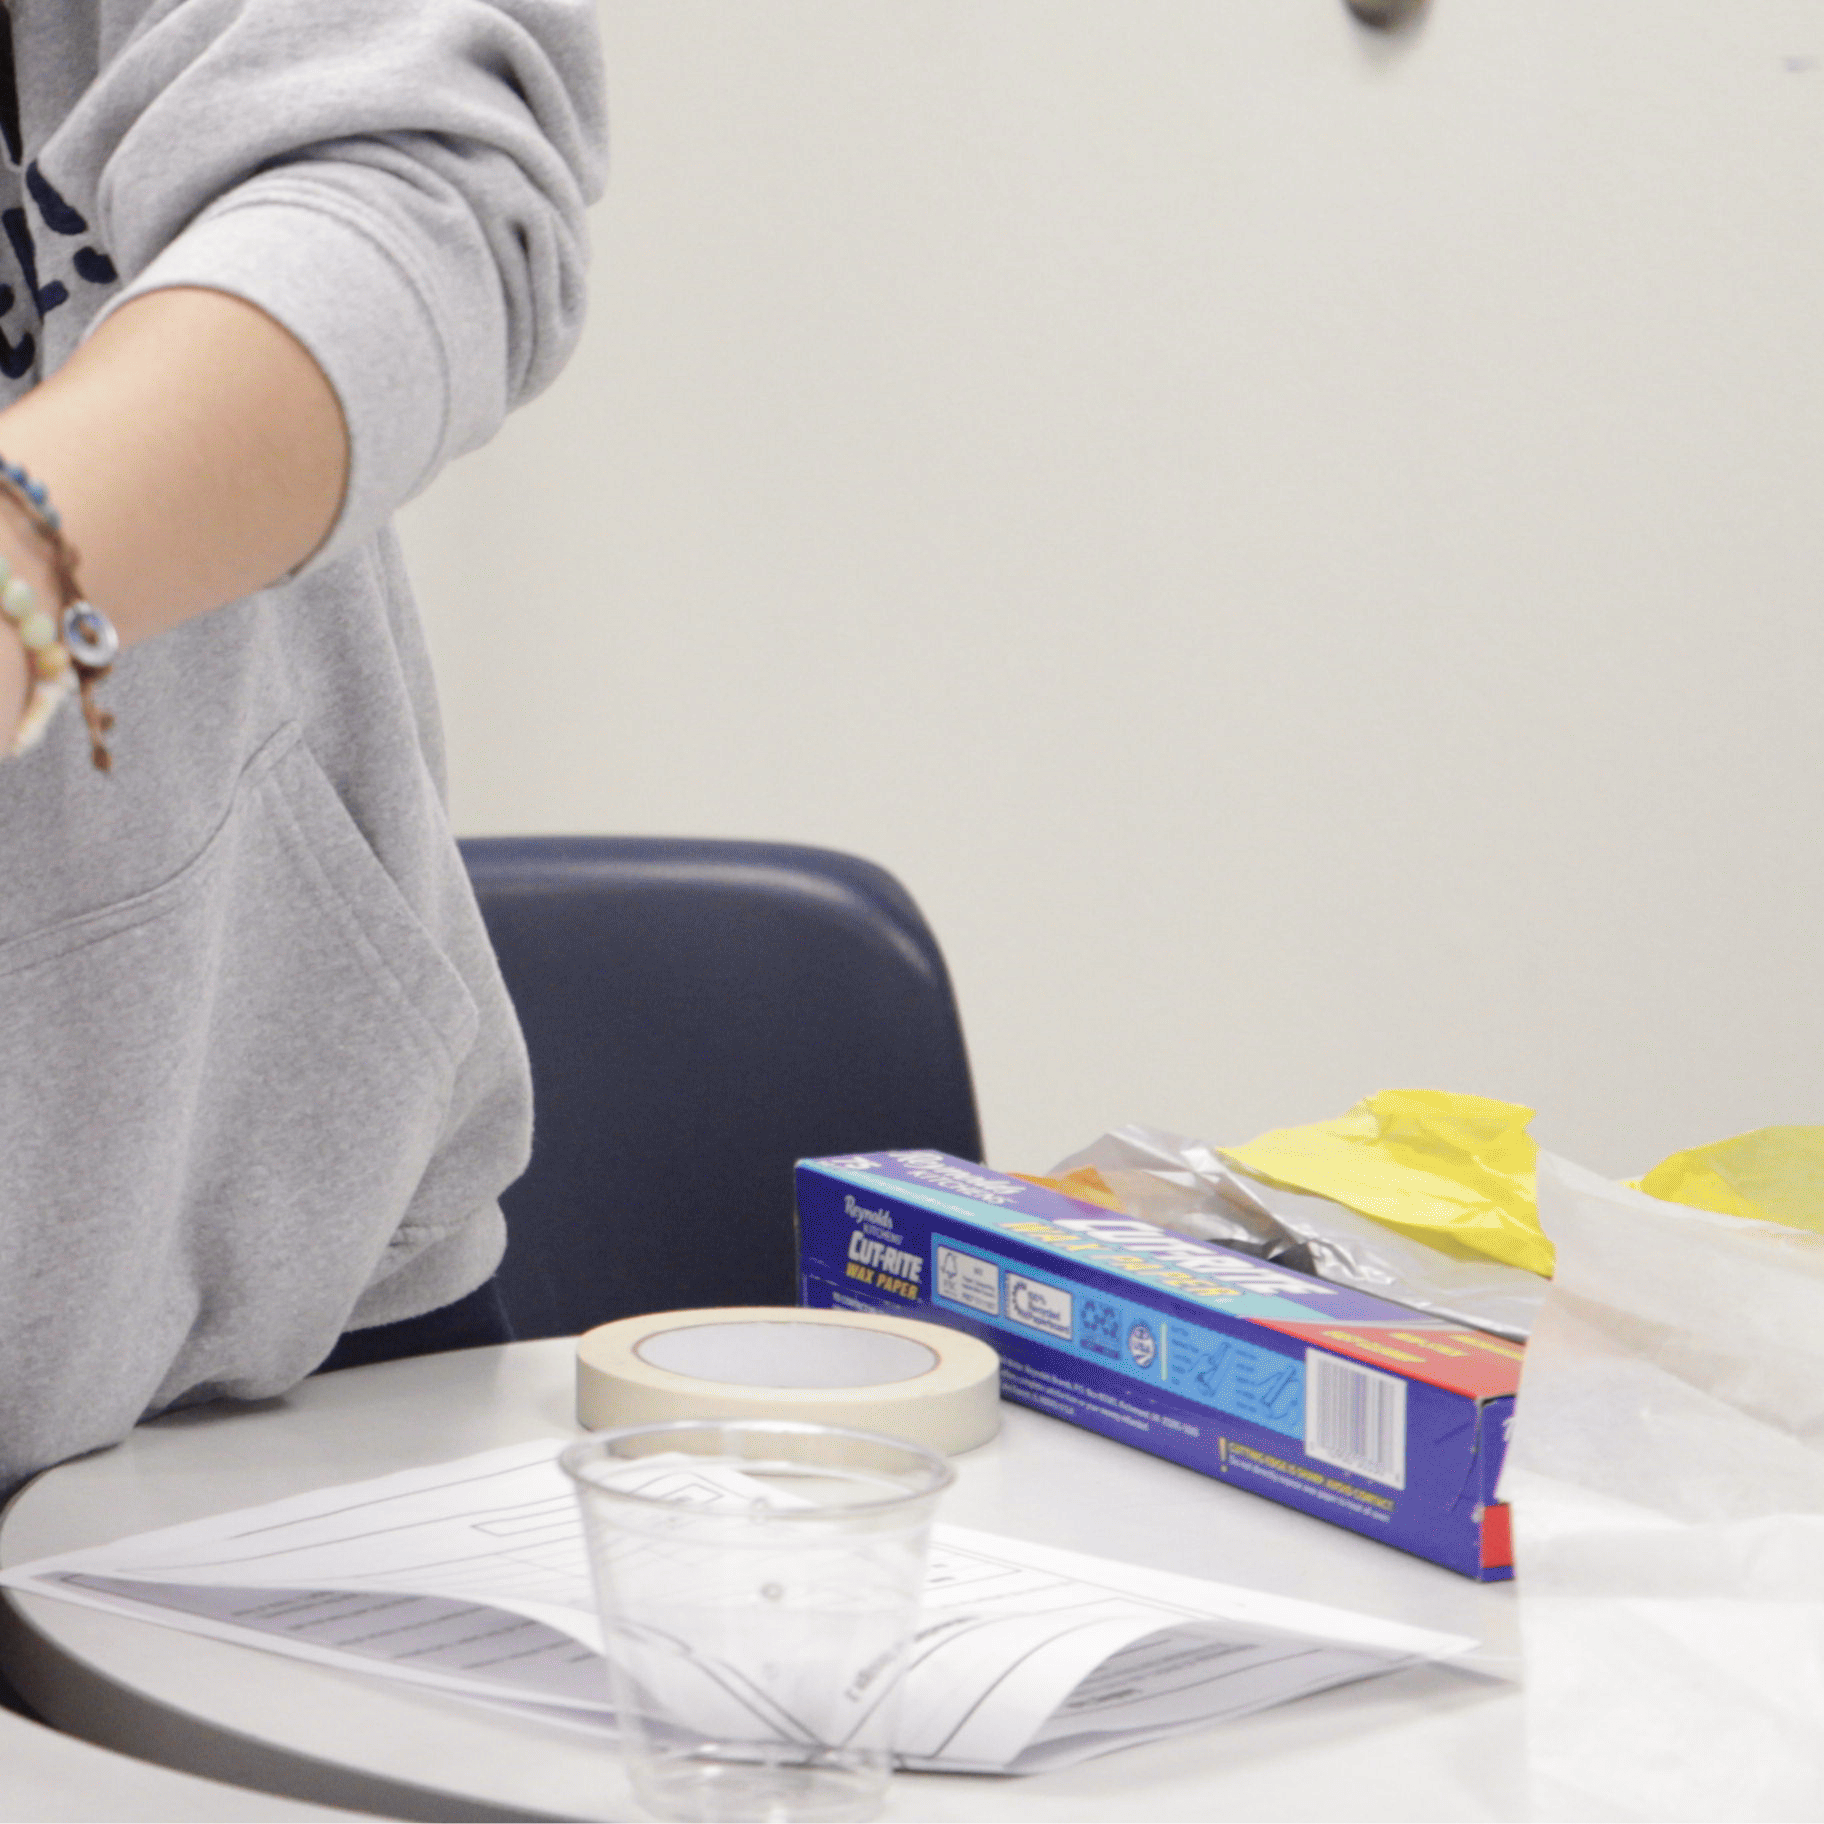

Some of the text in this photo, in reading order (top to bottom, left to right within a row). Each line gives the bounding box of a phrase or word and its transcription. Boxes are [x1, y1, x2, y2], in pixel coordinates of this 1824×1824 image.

[888, 1150, 1026, 1194] Reynolds
[843, 1194, 893, 1228] Reynolds
[848, 1230, 924, 1283] CUT-RITE
[1001, 1222, 1242, 1296] WAX PAPER
[1053, 1219, 1339, 1295] CUT-RITE
[846, 1261, 875, 1285] WAX
[876, 1272, 920, 1301] PAPER
